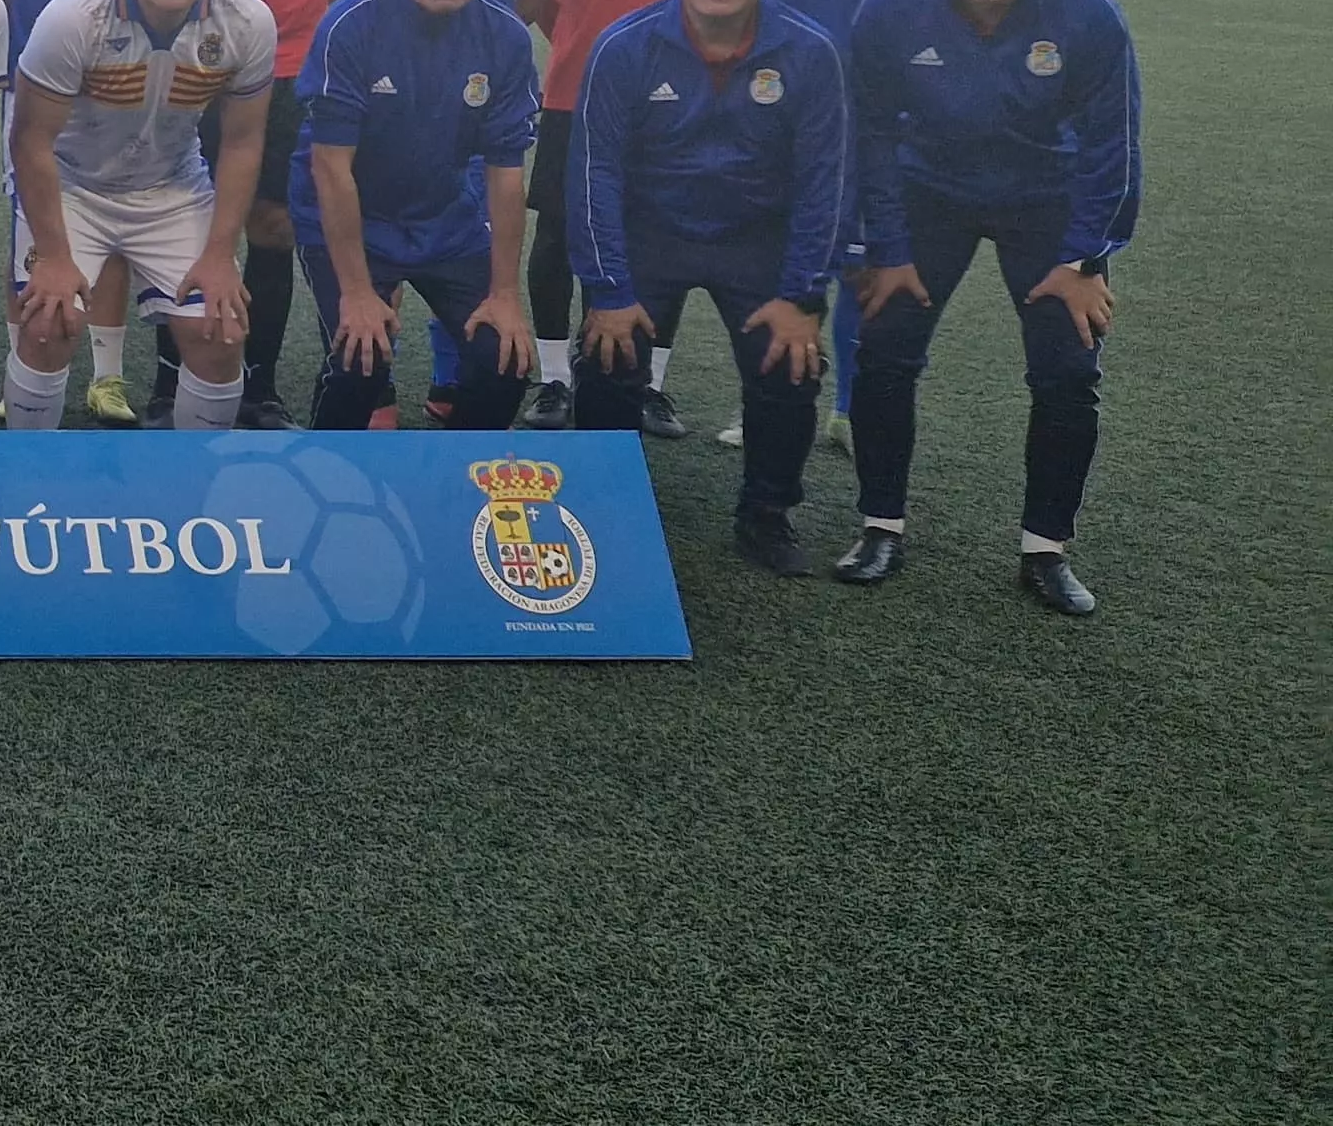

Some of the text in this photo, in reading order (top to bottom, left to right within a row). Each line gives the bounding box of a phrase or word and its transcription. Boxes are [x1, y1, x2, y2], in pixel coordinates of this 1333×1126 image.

[475, 515, 489, 542] REAL
[505, 622, 557, 631] FUNDADA
[558, 622, 574, 631] EN
